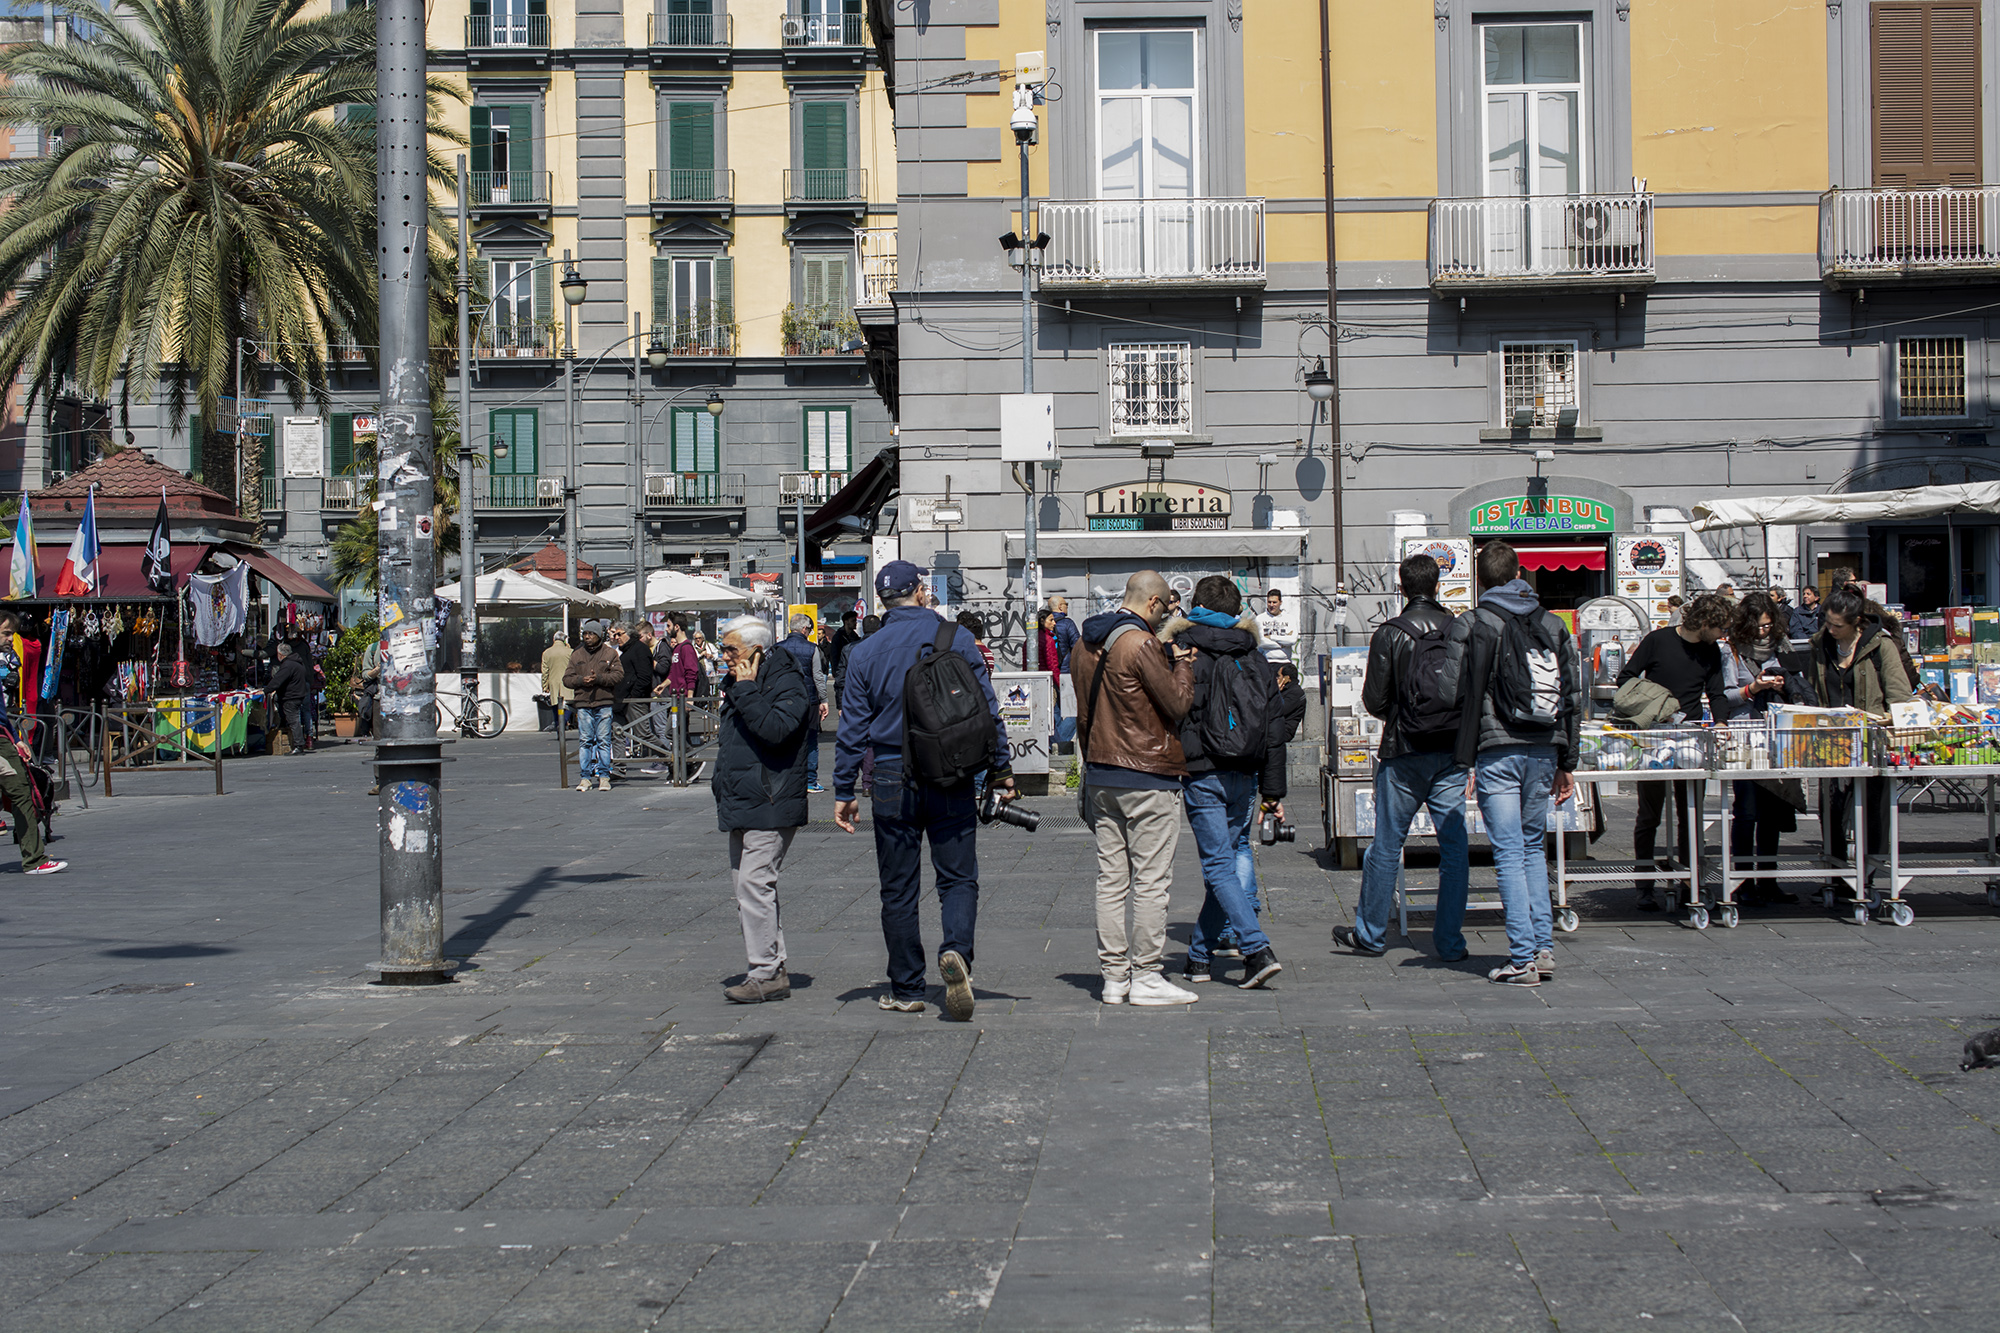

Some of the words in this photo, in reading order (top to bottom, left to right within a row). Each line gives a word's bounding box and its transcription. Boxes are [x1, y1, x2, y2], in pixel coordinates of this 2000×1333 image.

[1095, 488, 1223, 513] Libreria
[1477, 498, 1609, 525] ISTANBUL
[1091, 518, 1107, 530] LIBRI
[1108, 518, 1143, 530] SCOLASTICI
[1173, 518, 1190, 529] LIBRI
[1190, 518, 1226, 529] SCOLASTICI
[1509, 517, 1572, 530] KEBAB
[1630, 540, 1666, 559] ISTANBUL
